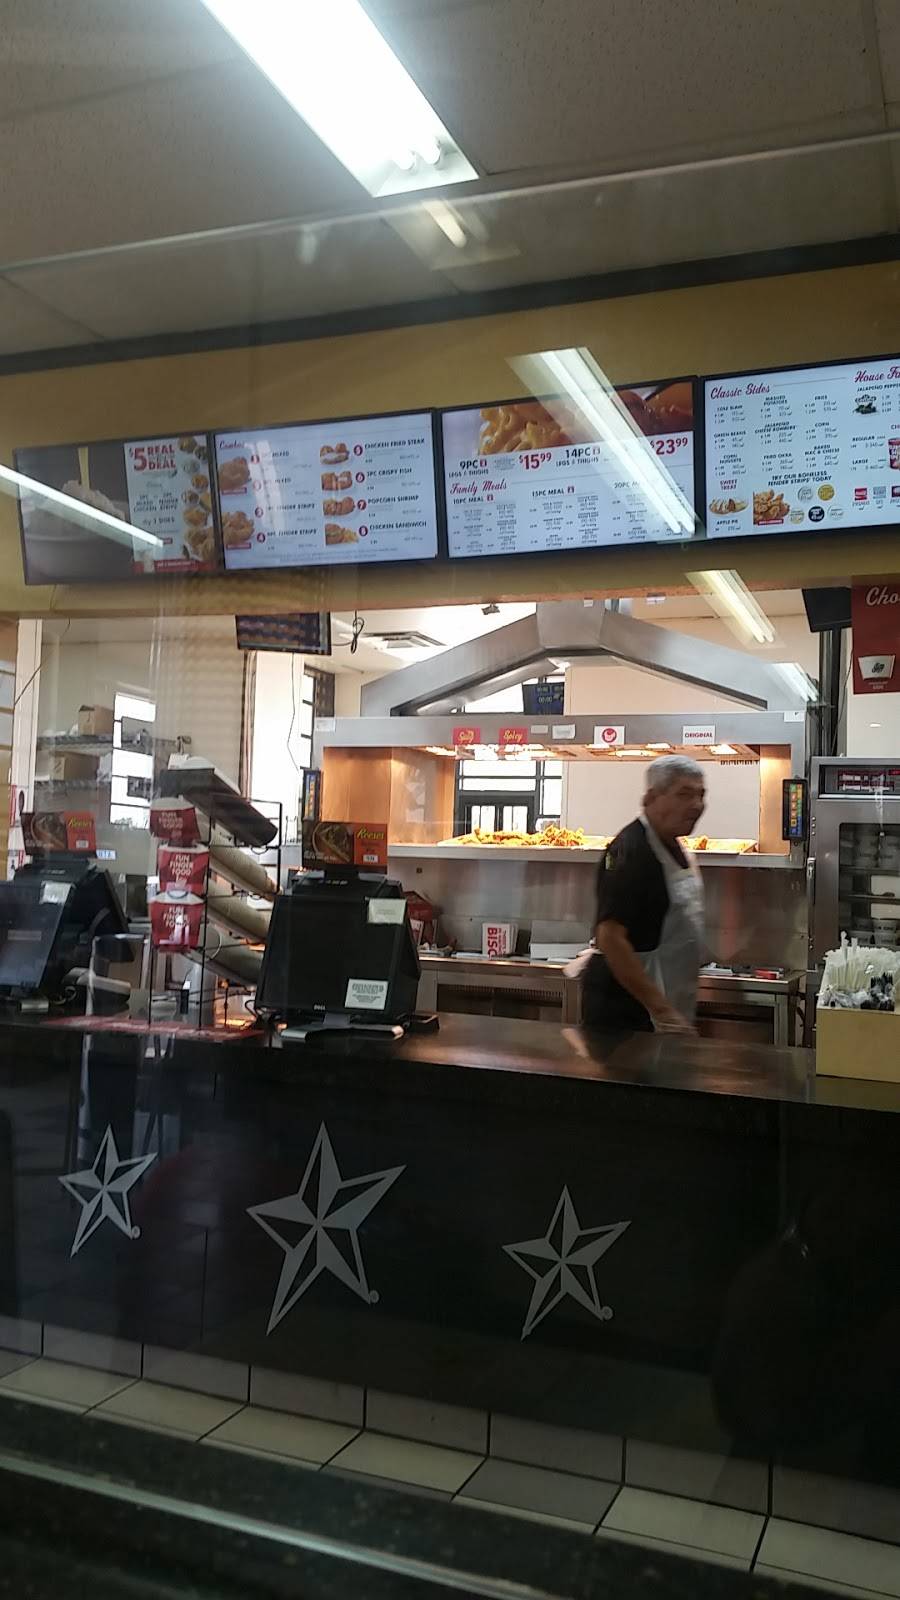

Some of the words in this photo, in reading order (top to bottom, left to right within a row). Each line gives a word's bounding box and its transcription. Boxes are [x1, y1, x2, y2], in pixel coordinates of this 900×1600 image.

[854, 370, 884, 383] House
[710, 386, 742, 400] Classic
[745, 382, 770, 396] Sides
[390, 440, 407, 448] FRIED
[407, 438, 425, 446] STEAK
[147, 444, 176, 456] REAL
[565, 447, 591, 459] 14PC
[148, 460, 177, 470] DEAL
[460, 459, 478, 470] 9PC
[450, 481, 478, 496] Family
[482, 478, 507, 491] Meals
[547, 488, 564, 496] MEAL
[502, 729, 523, 743] Spicy
[175, 854, 190, 863] FUN
[169, 861, 194, 869] FINGER
[172, 867, 192, 876] FOOD
[168, 906, 185, 914] FUN
